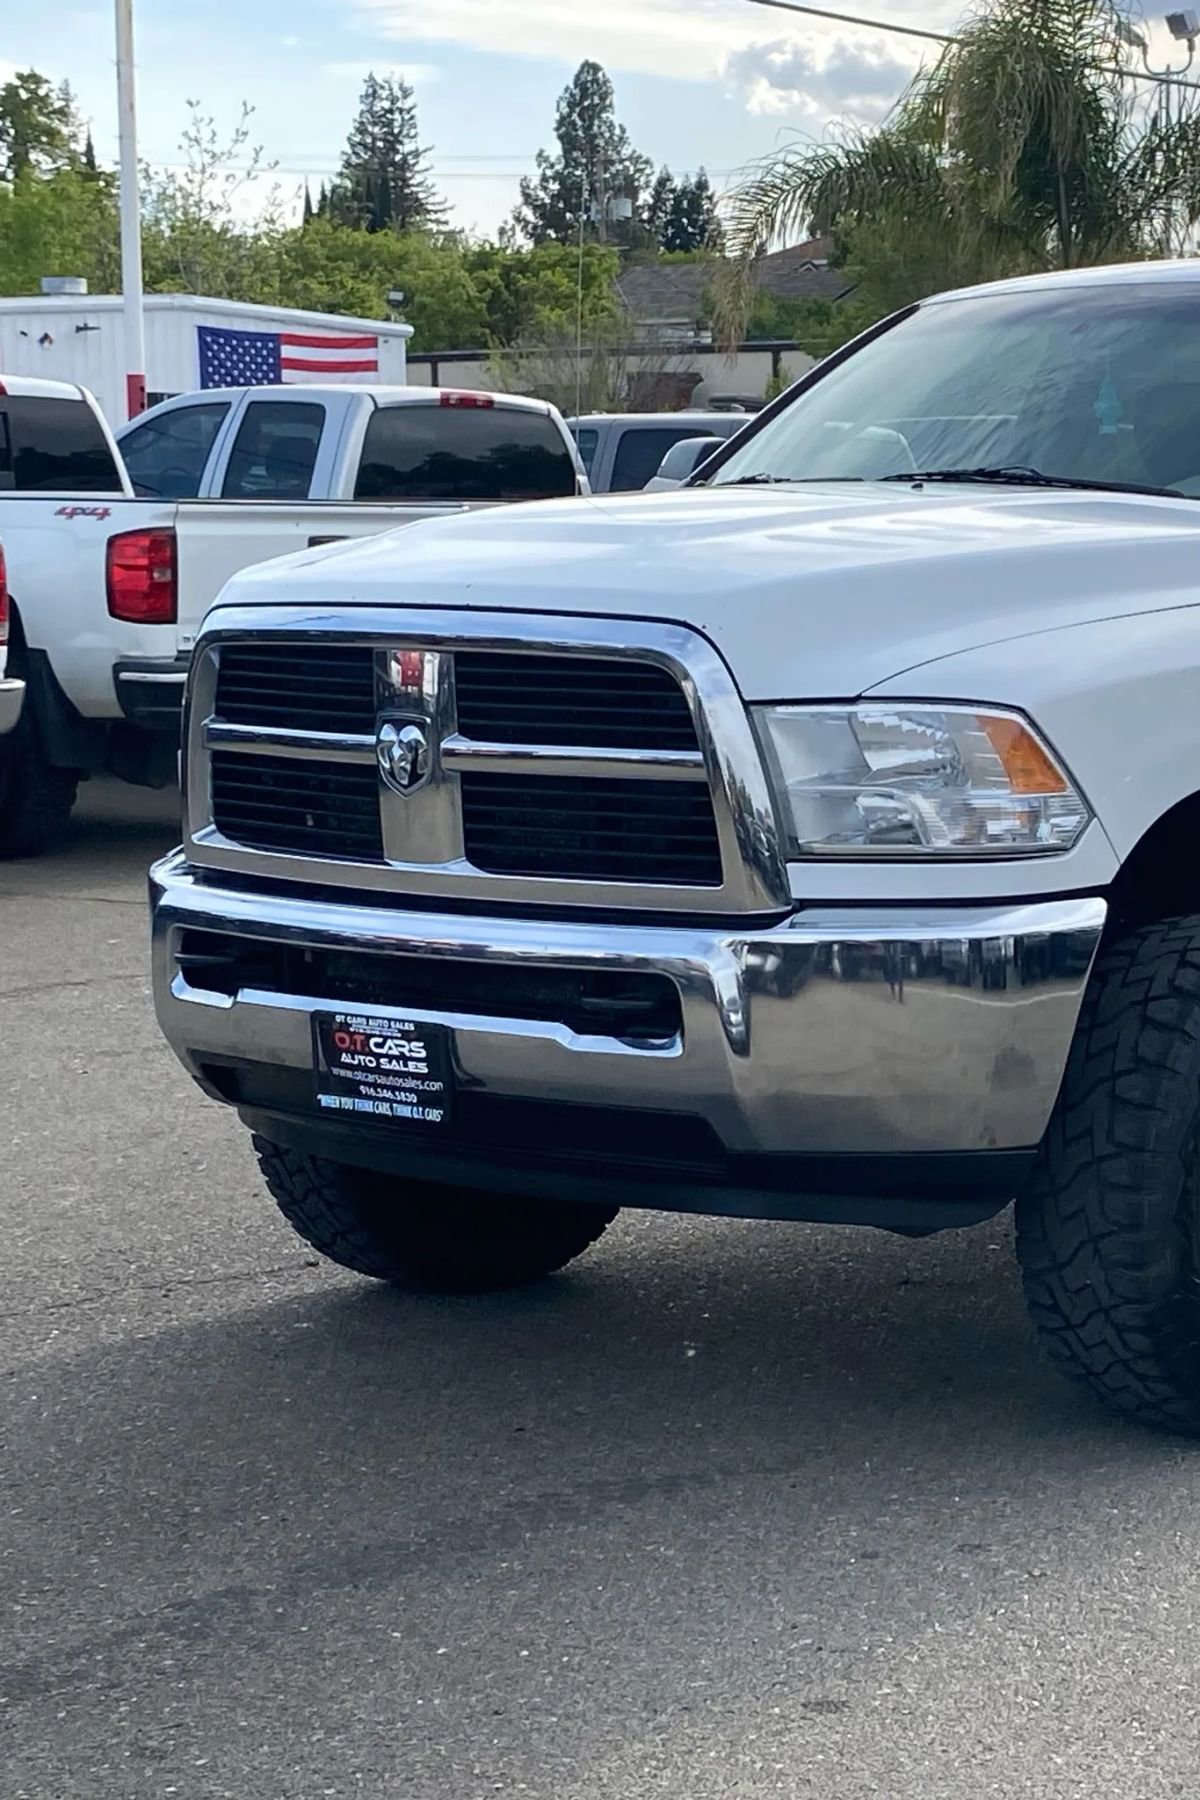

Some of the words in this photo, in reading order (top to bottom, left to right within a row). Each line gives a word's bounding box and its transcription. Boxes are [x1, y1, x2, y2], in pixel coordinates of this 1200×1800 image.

[346, 1016, 367, 1026] CARS
[368, 1018, 389, 1029] AUTO
[390, 1020, 415, 1031] SALES
[340, 1052, 377, 1068] AUTO
[379, 1057, 429, 1074] SALES
